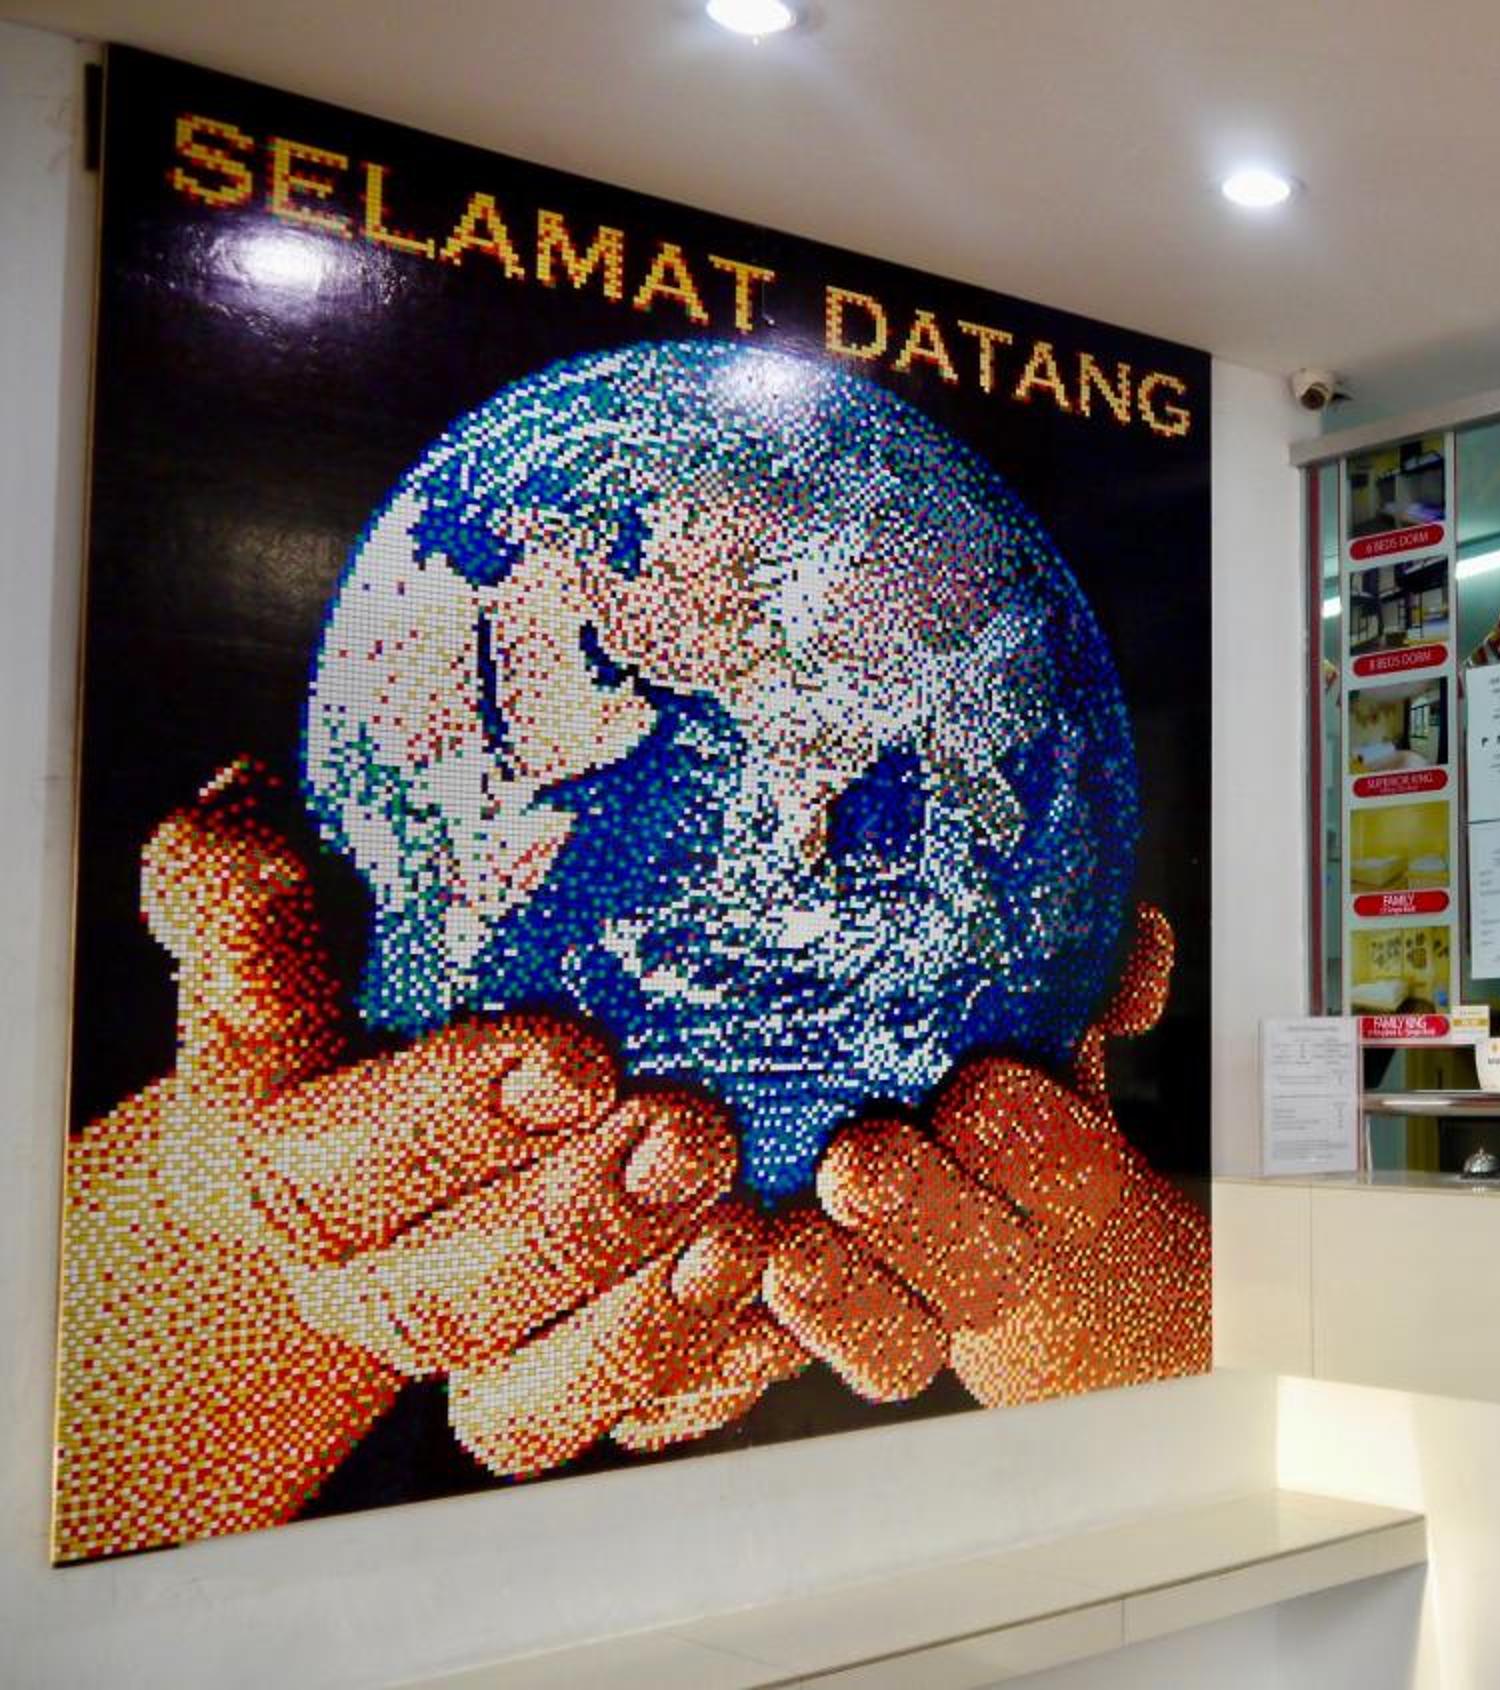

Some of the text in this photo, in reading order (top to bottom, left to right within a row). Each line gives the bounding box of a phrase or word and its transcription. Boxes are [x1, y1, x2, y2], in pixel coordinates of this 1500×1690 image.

[166, 112, 1191, 437] SELAMAT DATANG
[1374, 536, 1398, 551] BEDS
[1399, 532, 1429, 547] DORM
[1376, 656, 1399, 669] BEDS
[1401, 651, 1431, 666] DORM
[1410, 773, 1433, 785] KING
[1383, 892, 1416, 906] FAMILY
[1373, 1016, 1403, 1030] FAMILY
